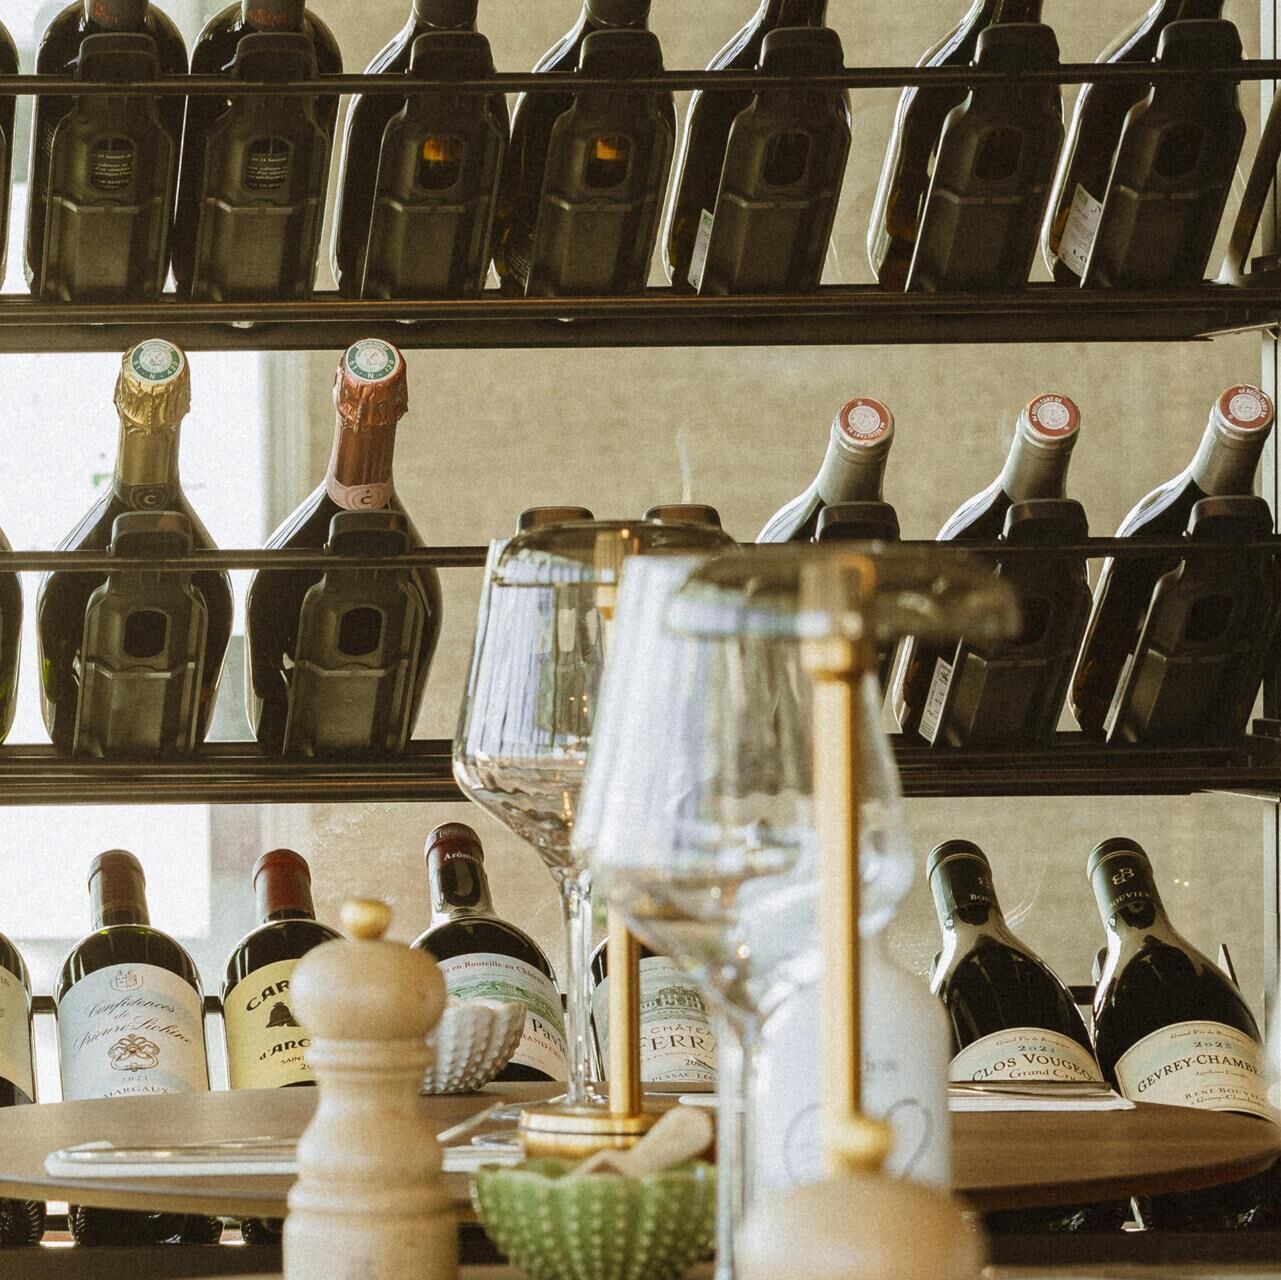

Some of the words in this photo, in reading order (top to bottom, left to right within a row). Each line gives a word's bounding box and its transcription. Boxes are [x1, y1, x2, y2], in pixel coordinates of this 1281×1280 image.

[246, 980, 290, 1011] CAR
[532, 1018, 566, 1053] Pavi
[650, 1023, 714, 1037] CHÂTEA
[972, 1057, 1017, 1081] CLOS
[1022, 1053, 1097, 1081] VOUGEO
[1009, 1068, 1049, 1080] Grand
[104, 1086, 170, 1099] MARGAUX
